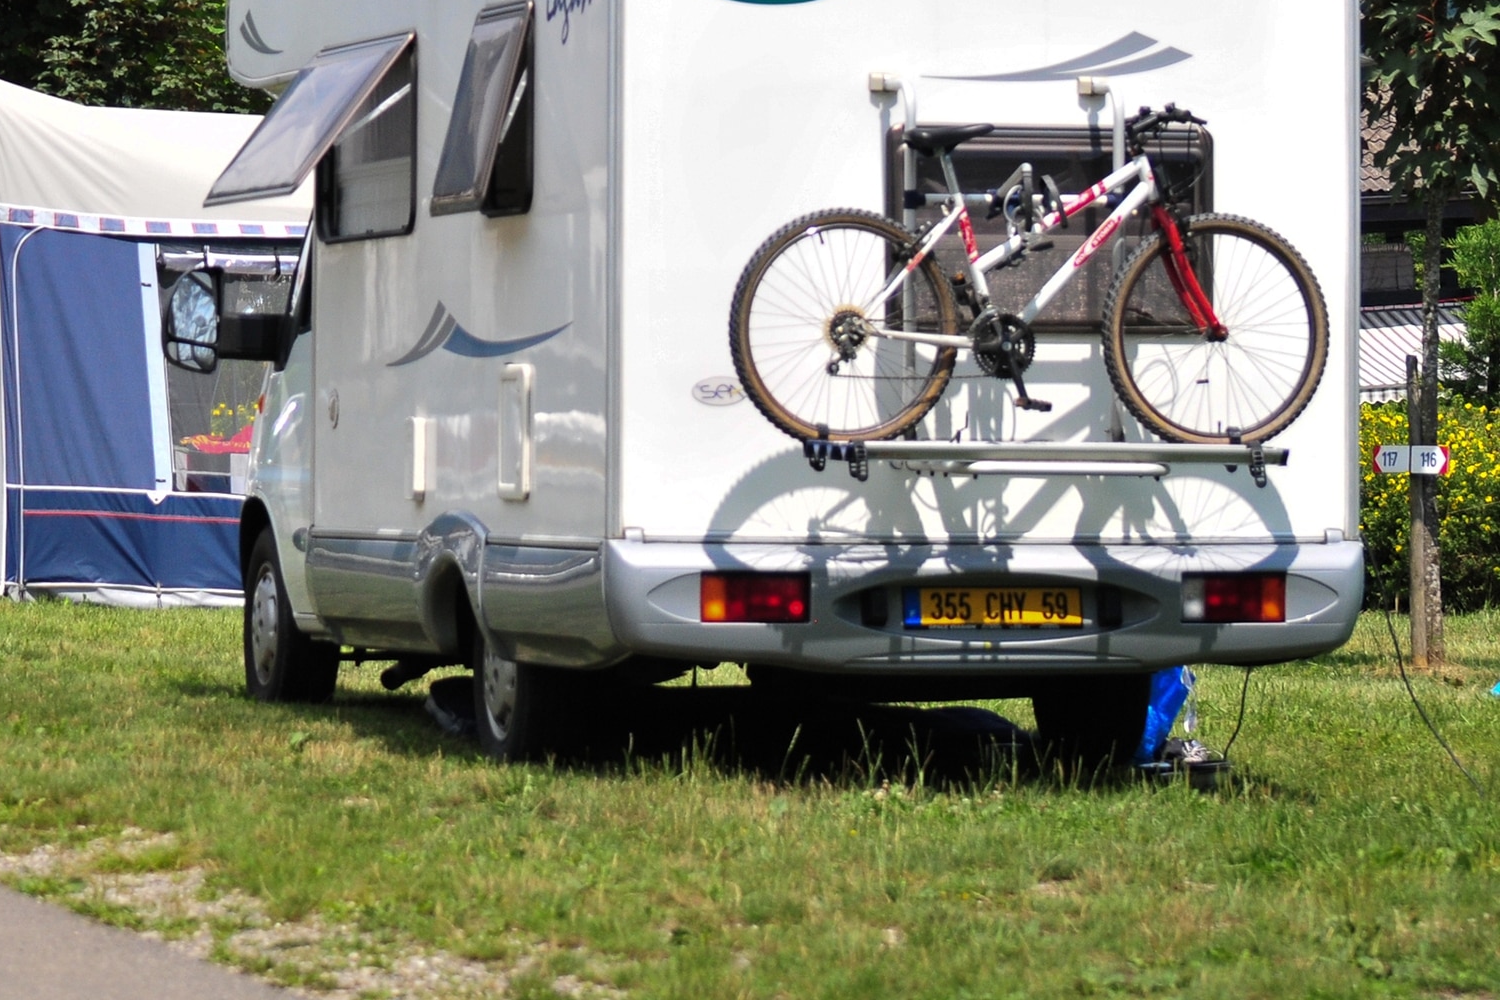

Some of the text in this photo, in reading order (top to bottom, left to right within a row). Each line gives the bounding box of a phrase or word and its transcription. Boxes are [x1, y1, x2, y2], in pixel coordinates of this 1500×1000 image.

[1382, 451, 1398, 467] 117
[1420, 452, 1437, 467] 116
[930, 592, 1068, 620] 355 CHY 59
